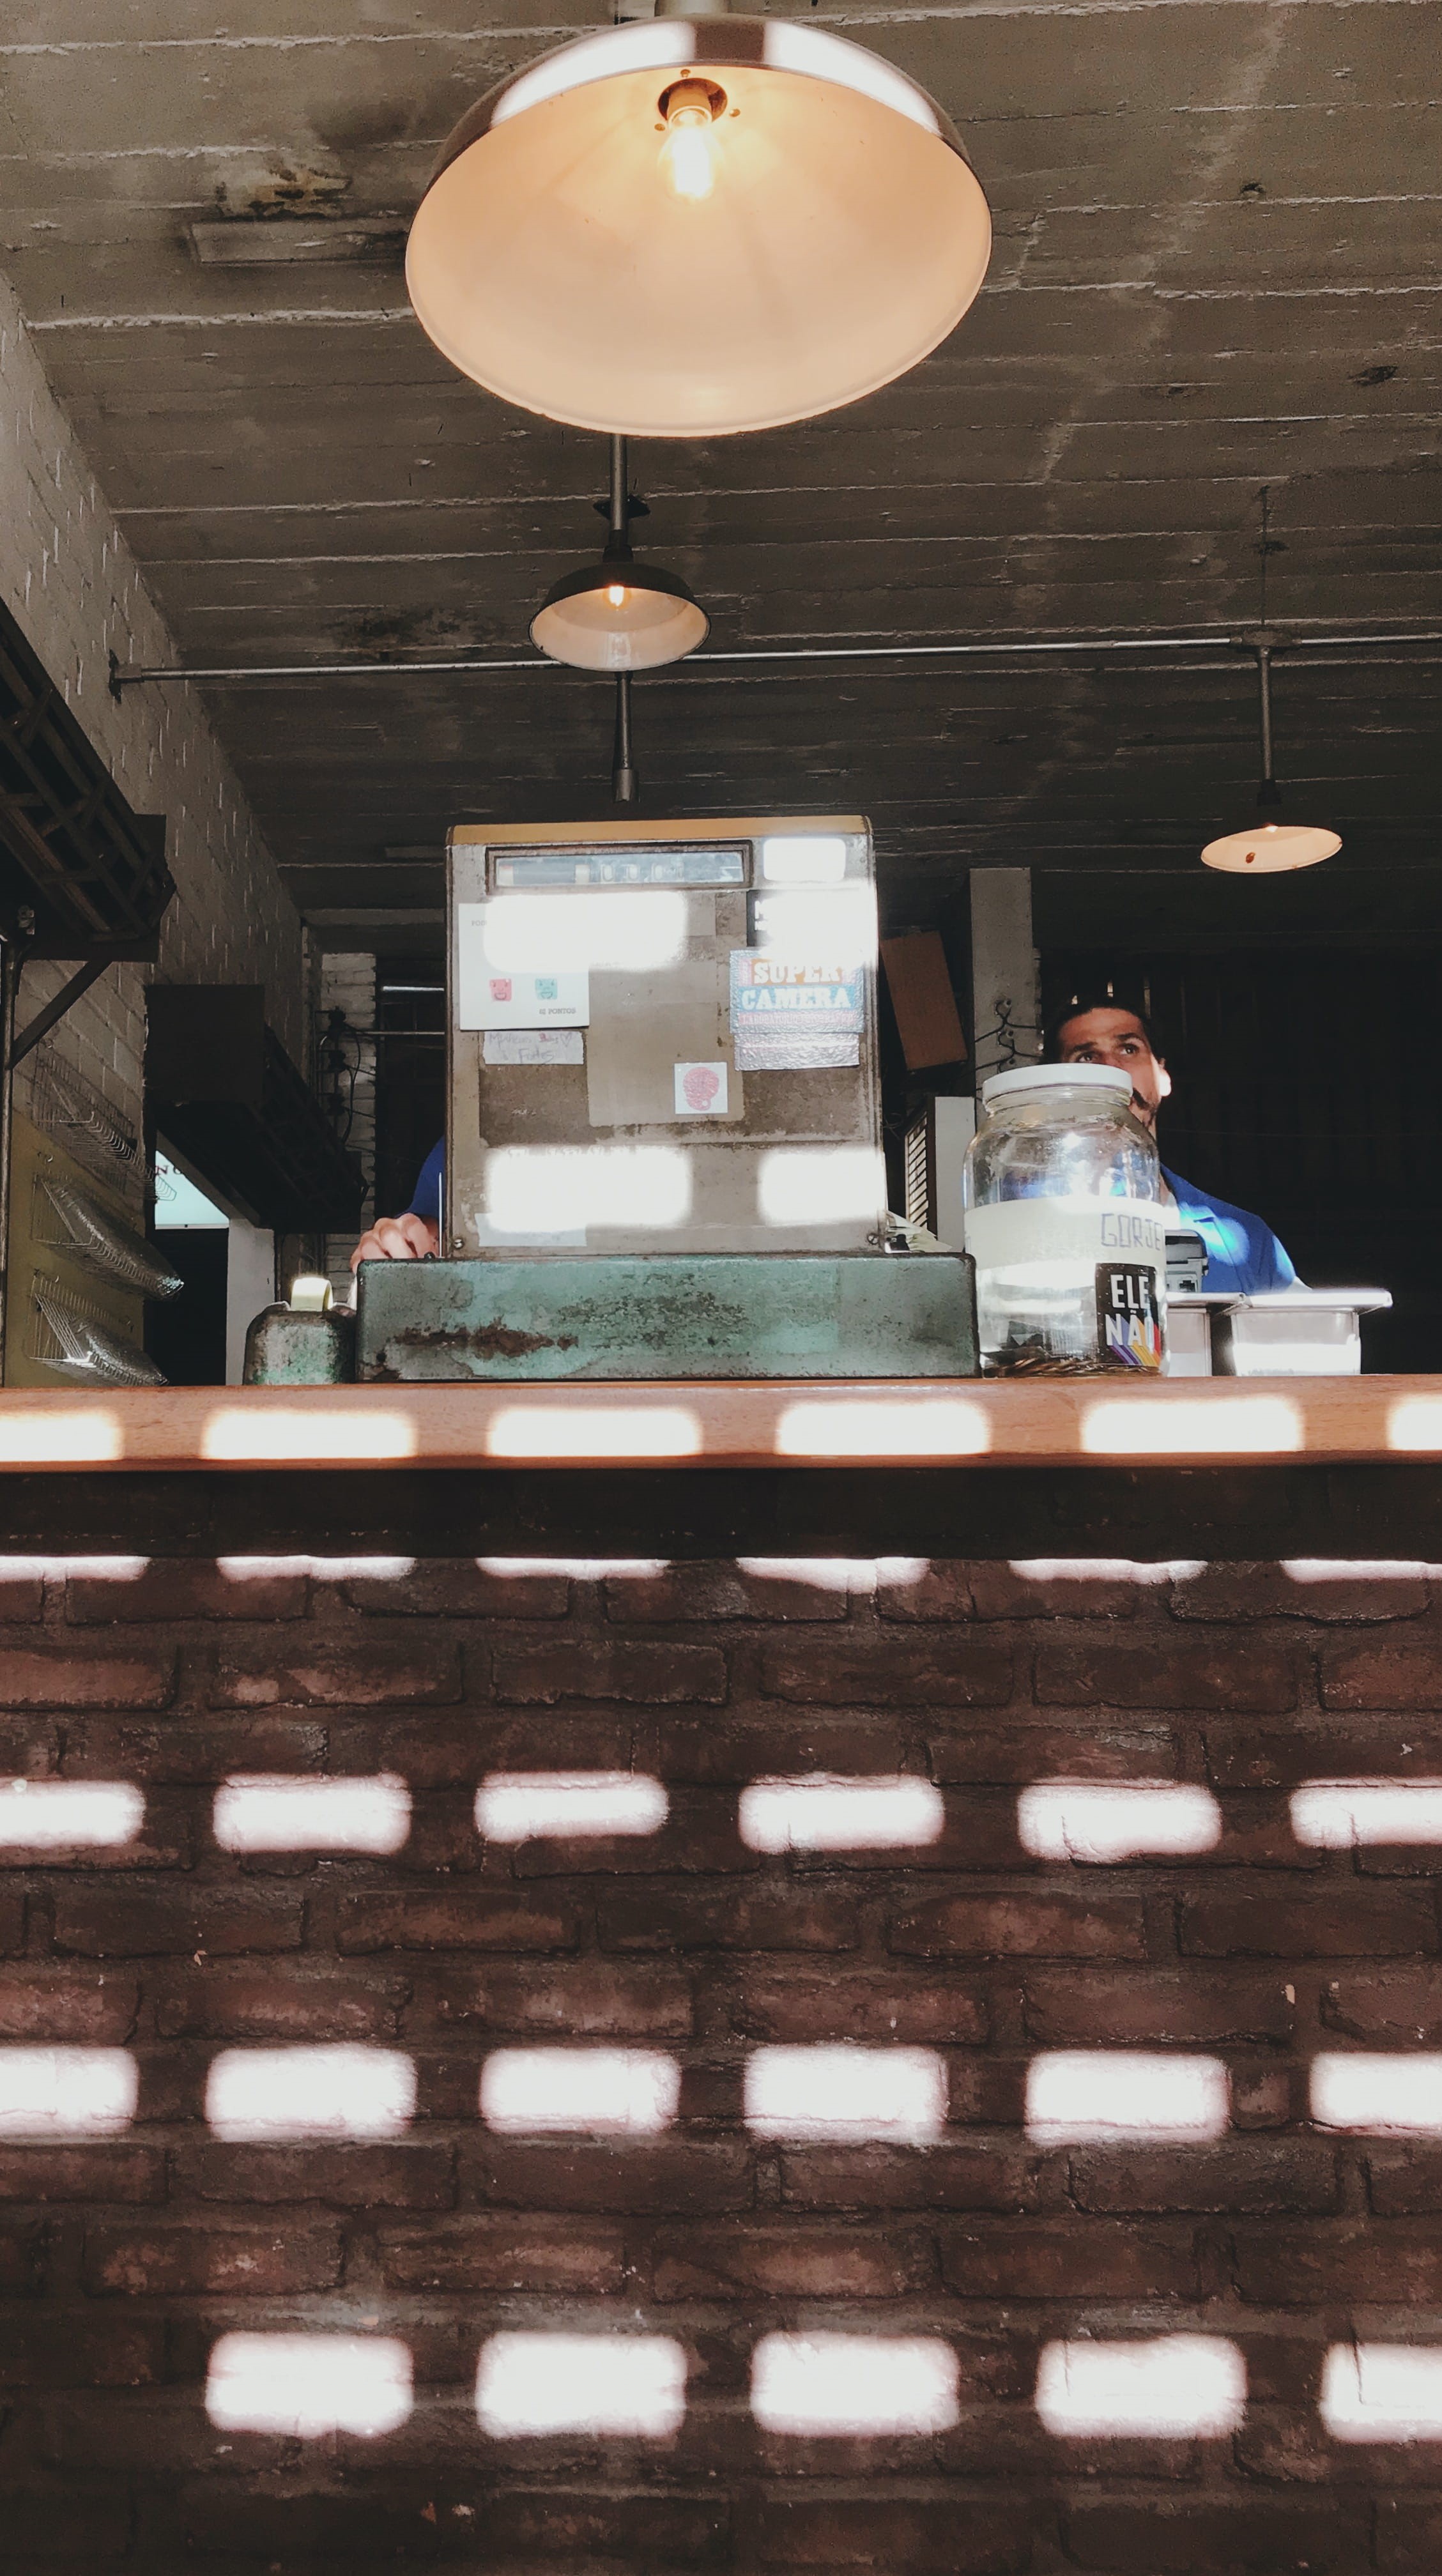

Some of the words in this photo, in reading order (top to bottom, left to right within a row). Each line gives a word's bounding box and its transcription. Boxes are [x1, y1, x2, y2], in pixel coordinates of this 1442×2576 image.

[754, 962, 840, 984] SUPER
[742, 987, 851, 1010] CAMERA
[1110, 1274, 1150, 1308] ELE
[1105, 1309, 1154, 1351] NÃO
